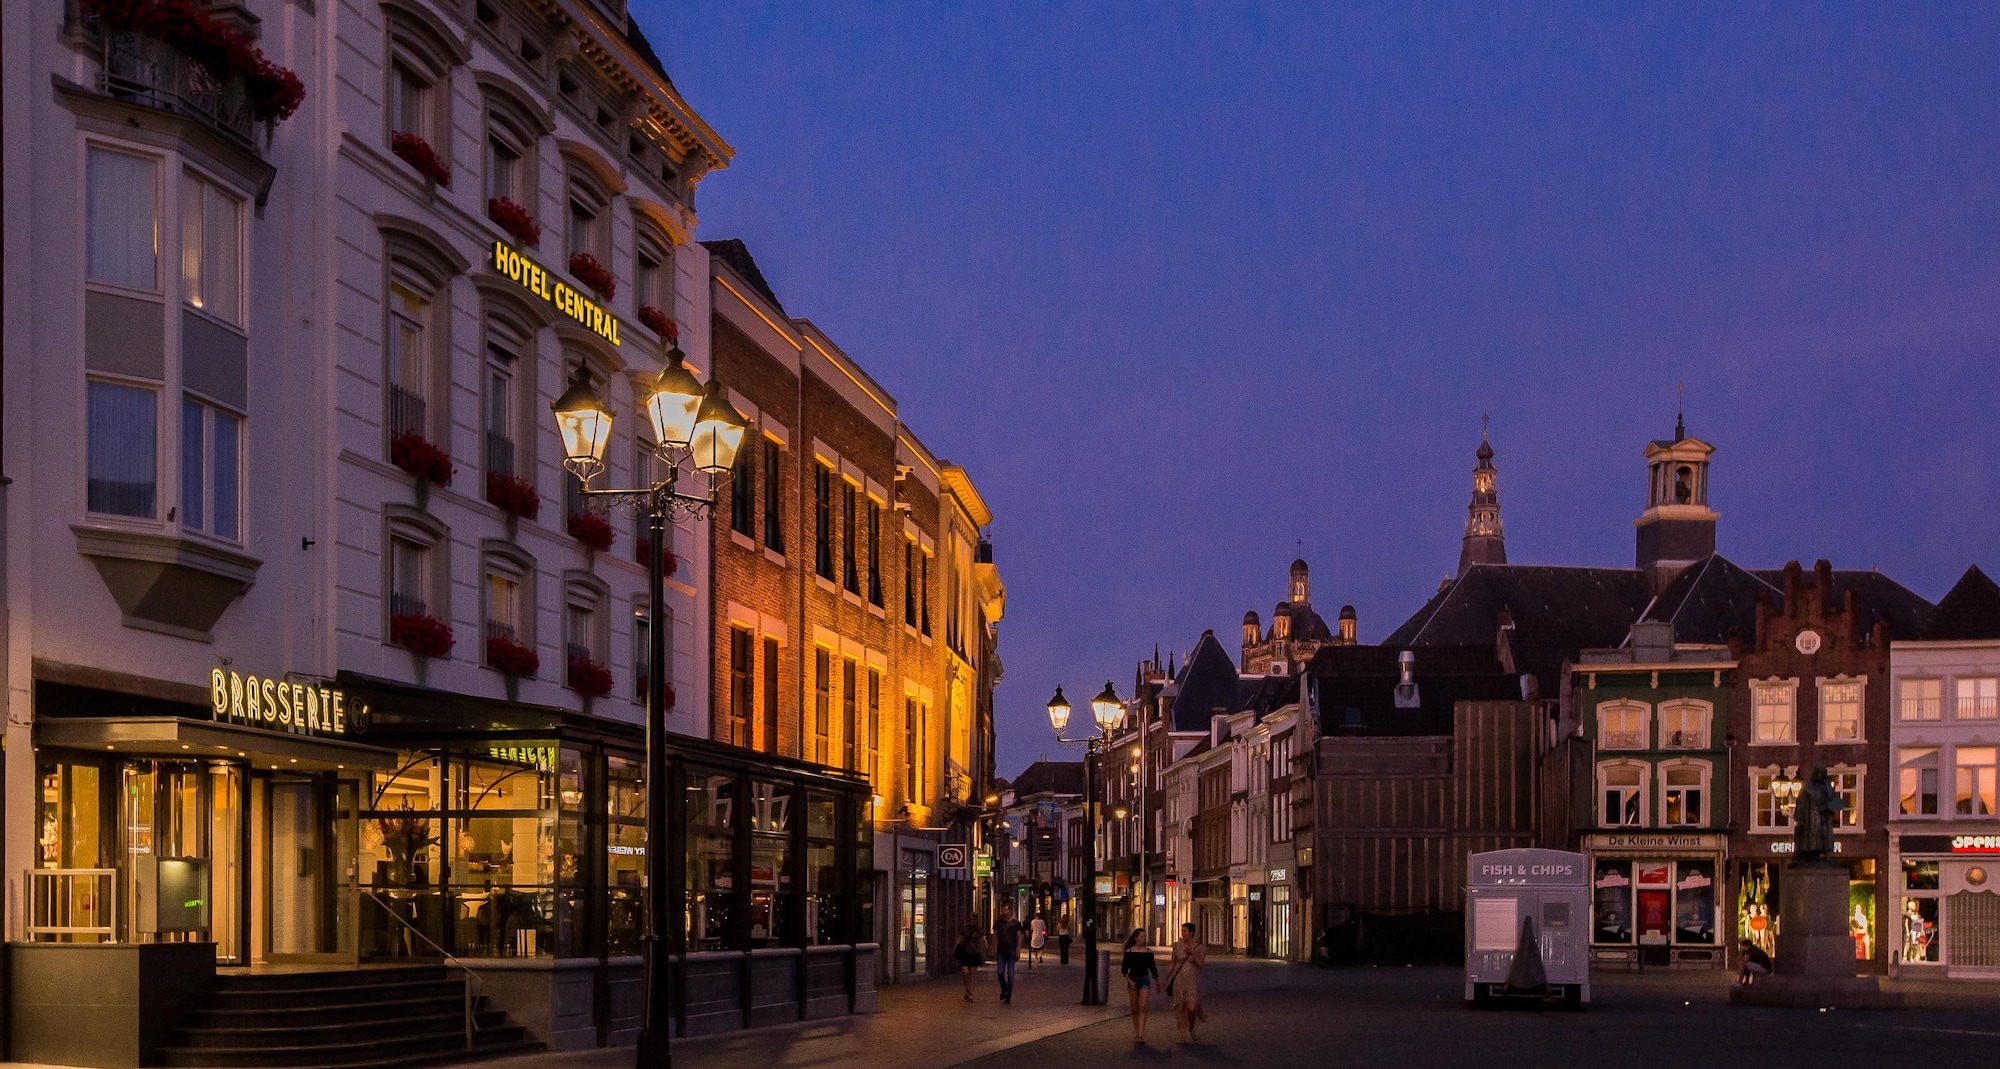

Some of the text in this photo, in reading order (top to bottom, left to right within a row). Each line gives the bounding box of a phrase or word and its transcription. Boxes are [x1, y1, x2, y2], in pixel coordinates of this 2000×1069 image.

[496, 241, 621, 346] HOTEL CENTRAL
[211, 667, 345, 734] BRASSERIE
[1608, 836, 1701, 846] De Kleine Winst
[1482, 864, 1573, 876] FISH & CHIPS
